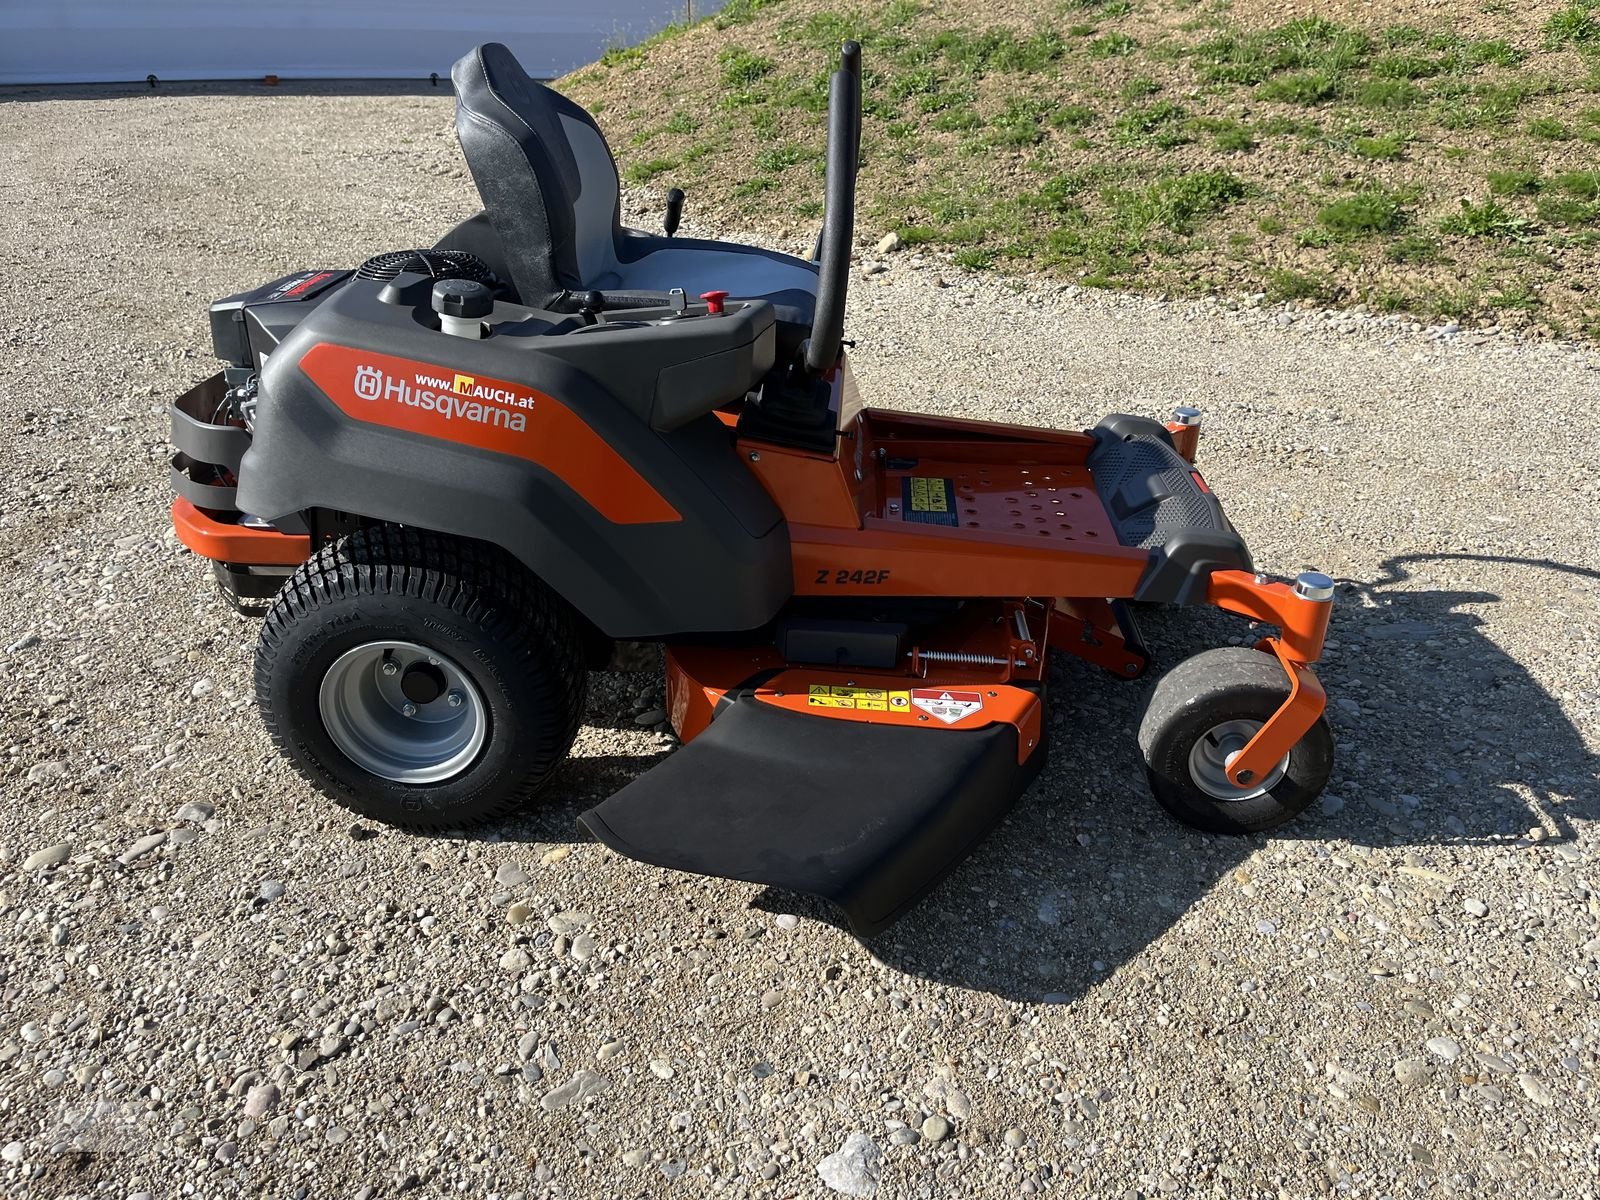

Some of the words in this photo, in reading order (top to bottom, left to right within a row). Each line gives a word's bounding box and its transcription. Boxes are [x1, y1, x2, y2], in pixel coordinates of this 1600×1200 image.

[384, 376, 527, 432] Husqvarna
[415, 374, 535, 410] www.MAUCH.at
[815, 570, 829, 584] Z
[835, 570, 890, 584] 242F
